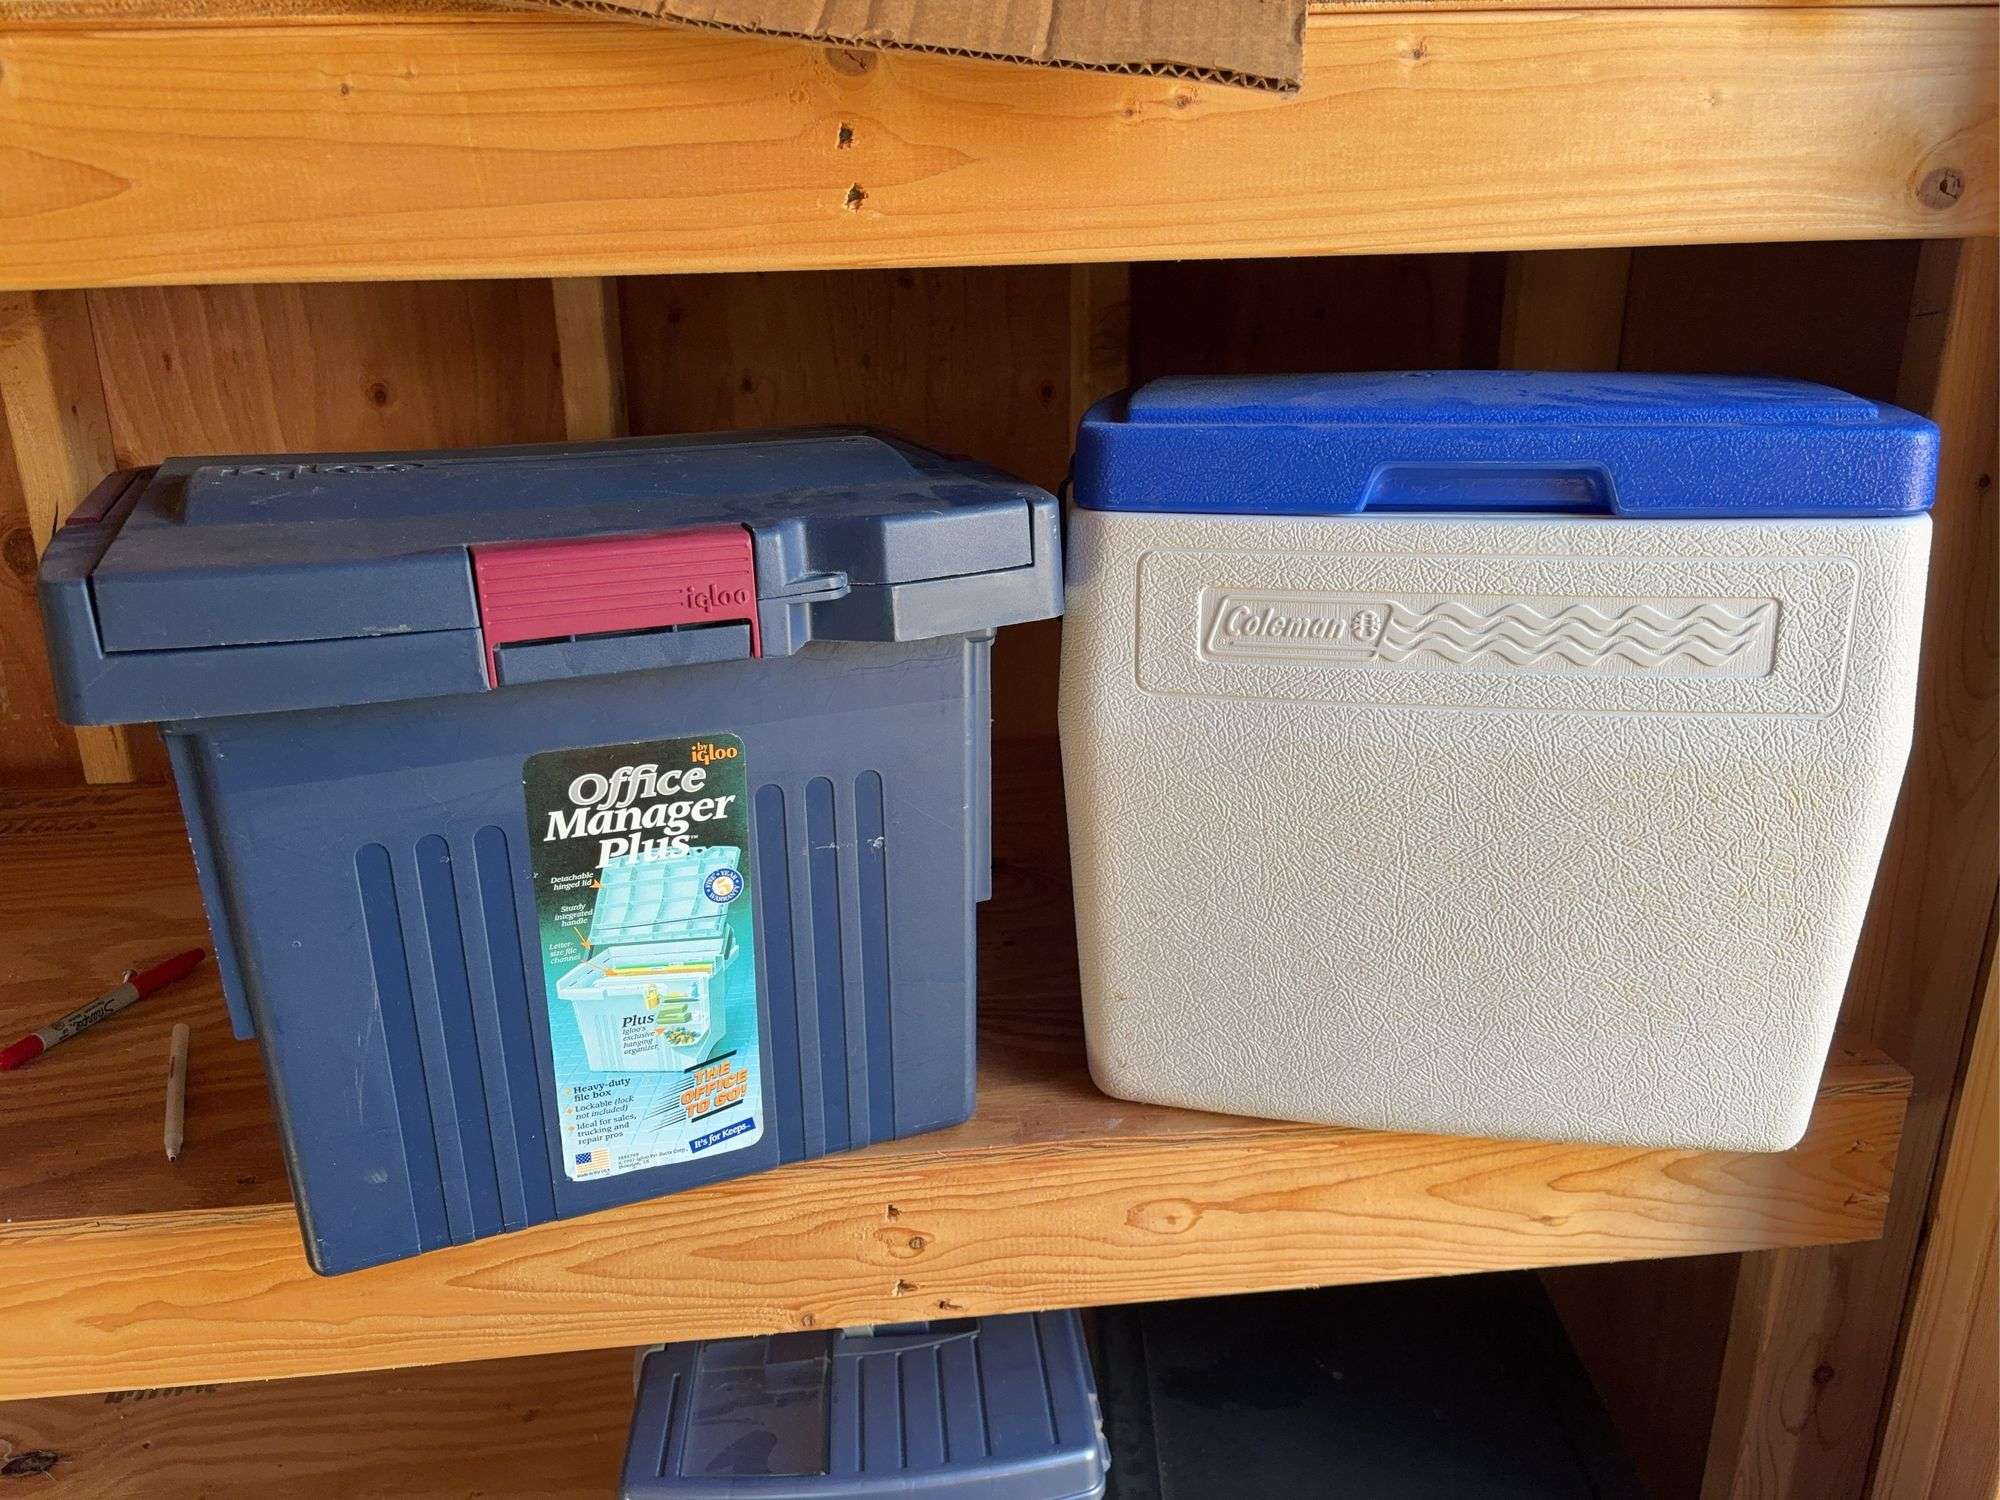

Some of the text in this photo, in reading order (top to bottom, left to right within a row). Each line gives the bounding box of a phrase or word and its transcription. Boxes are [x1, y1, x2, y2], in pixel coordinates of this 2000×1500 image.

[685, 584, 749, 613] igloo
[1224, 604, 1348, 640] Coleman
[691, 743, 738, 765] igloo
[697, 742, 709, 754] by
[568, 763, 707, 811] Office
[543, 794, 736, 842] Manager
[550, 871, 594, 884] Detachable
[553, 878, 592, 891] hinged lid
[560, 903, 586, 913] Sturdy
[561, 917, 588, 928] handle
[622, 1014, 655, 1029] Plus
[695, 1061, 730, 1085] THE
[573, 1078, 631, 1094] Heavy-duty
[681, 1069, 747, 1105] OFFICE
[574, 1089, 612, 1103] file box
[575, 1095, 634, 1112] Lockable (lock
[685, 1084, 747, 1119] TO GO!
[576, 1104, 629, 1120] not included)
[576, 1113, 637, 1130] Ideal for sales,
[613, 1121, 630, 1130] and
[578, 1131, 624, 1145] repair pros
[694, 1139, 708, 1149] It's
[708, 1132, 722, 1146] for
